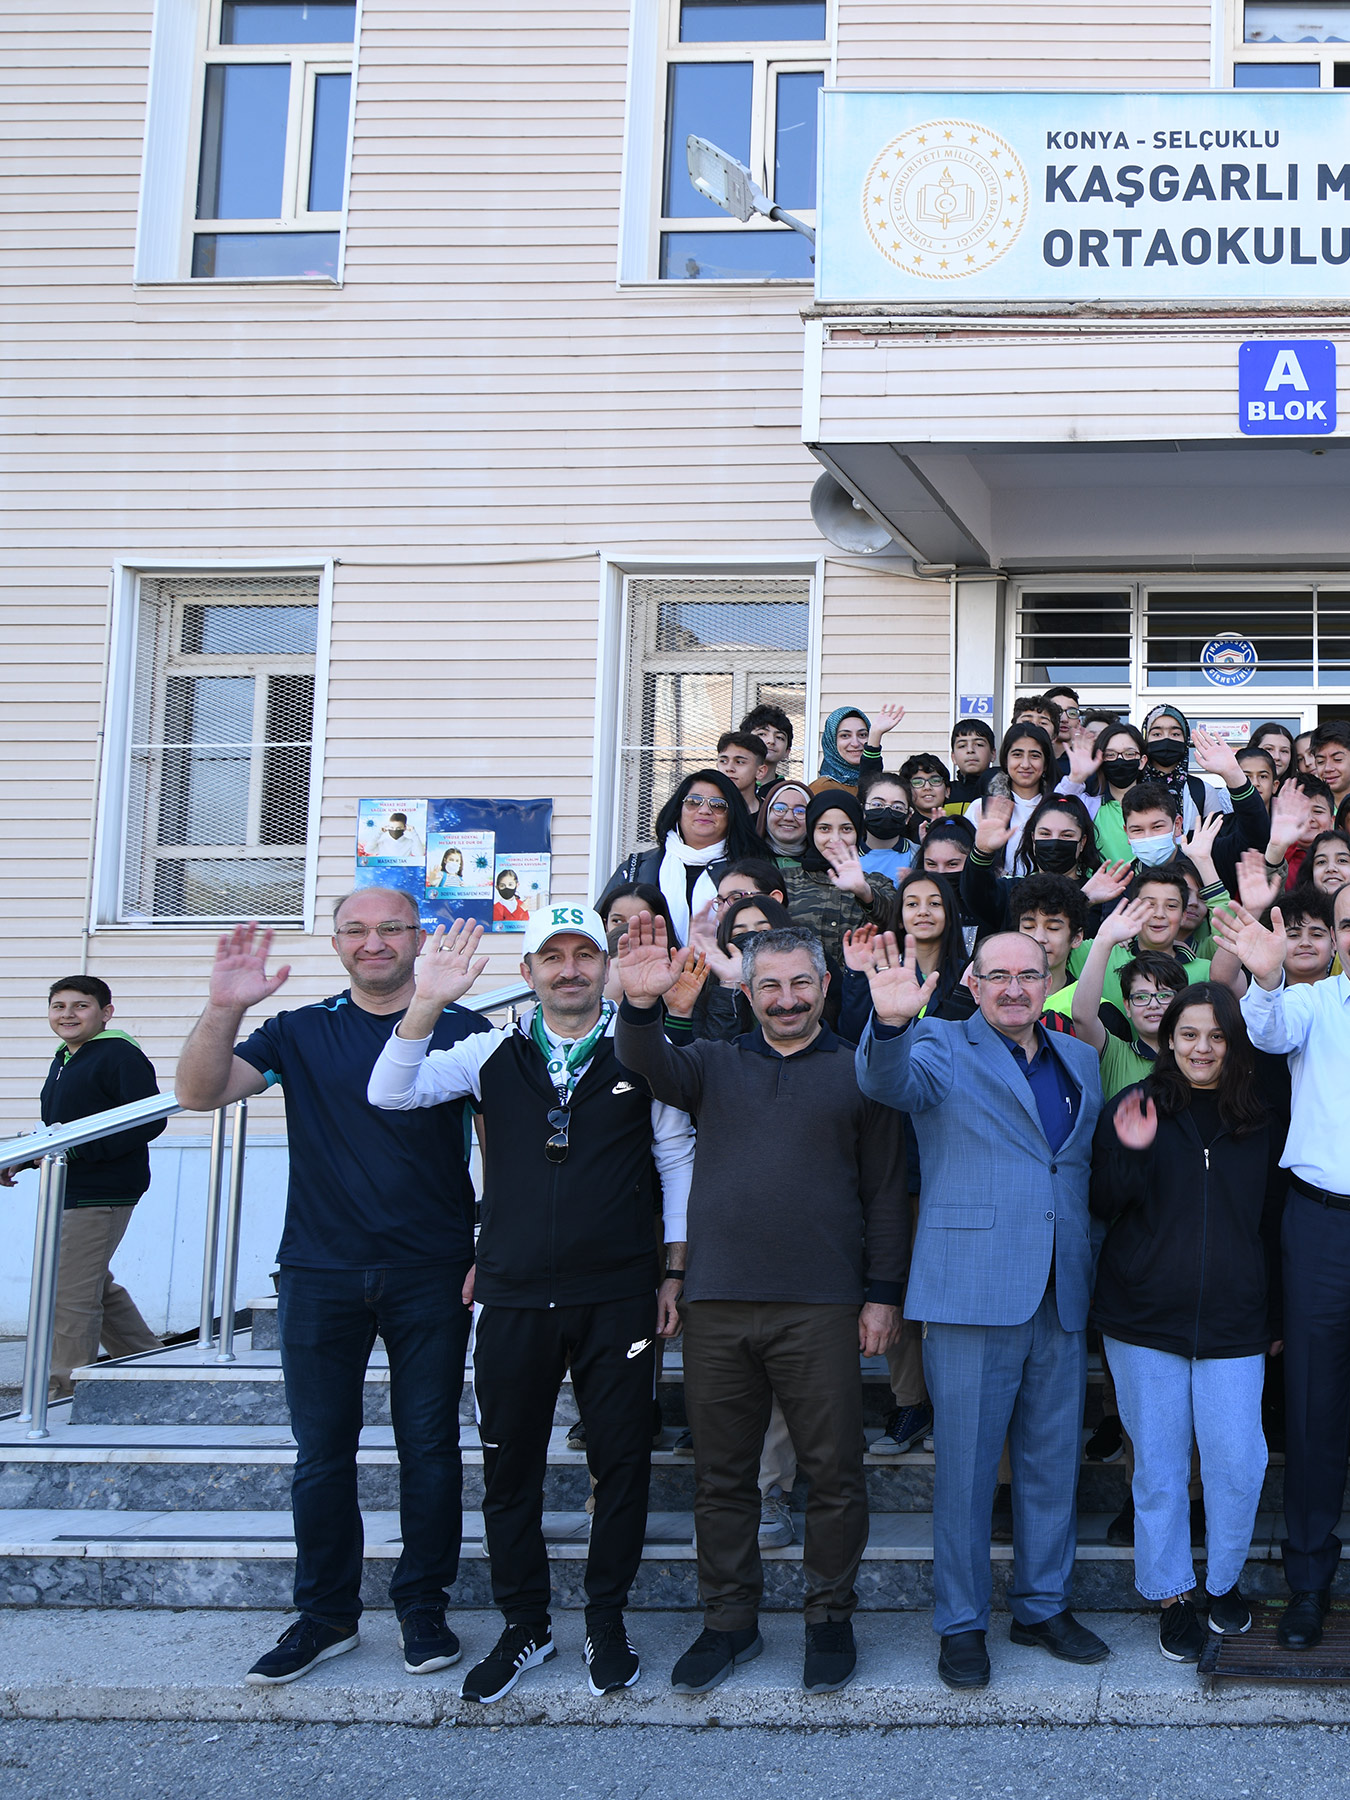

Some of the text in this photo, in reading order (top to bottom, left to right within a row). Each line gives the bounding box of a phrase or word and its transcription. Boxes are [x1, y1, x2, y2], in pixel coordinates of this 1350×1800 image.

[1046, 131, 1130, 149] KONYA
[1152, 130, 1280, 150] SELÇUKLU
[894, 150, 941, 212] CUMHURİYETİ
[975, 161, 998, 196] EĞİTİM
[1045, 163, 1298, 208] KAŞGARLI
[896, 214, 933, 249] TÜRKİYE
[956, 199, 998, 248] BAKANLIĞI
[1264, 349, 1310, 391] A
[1247, 400, 1327, 420] BLOK
[966, 697, 989, 713] 75
[551, 907, 584, 926] KS
